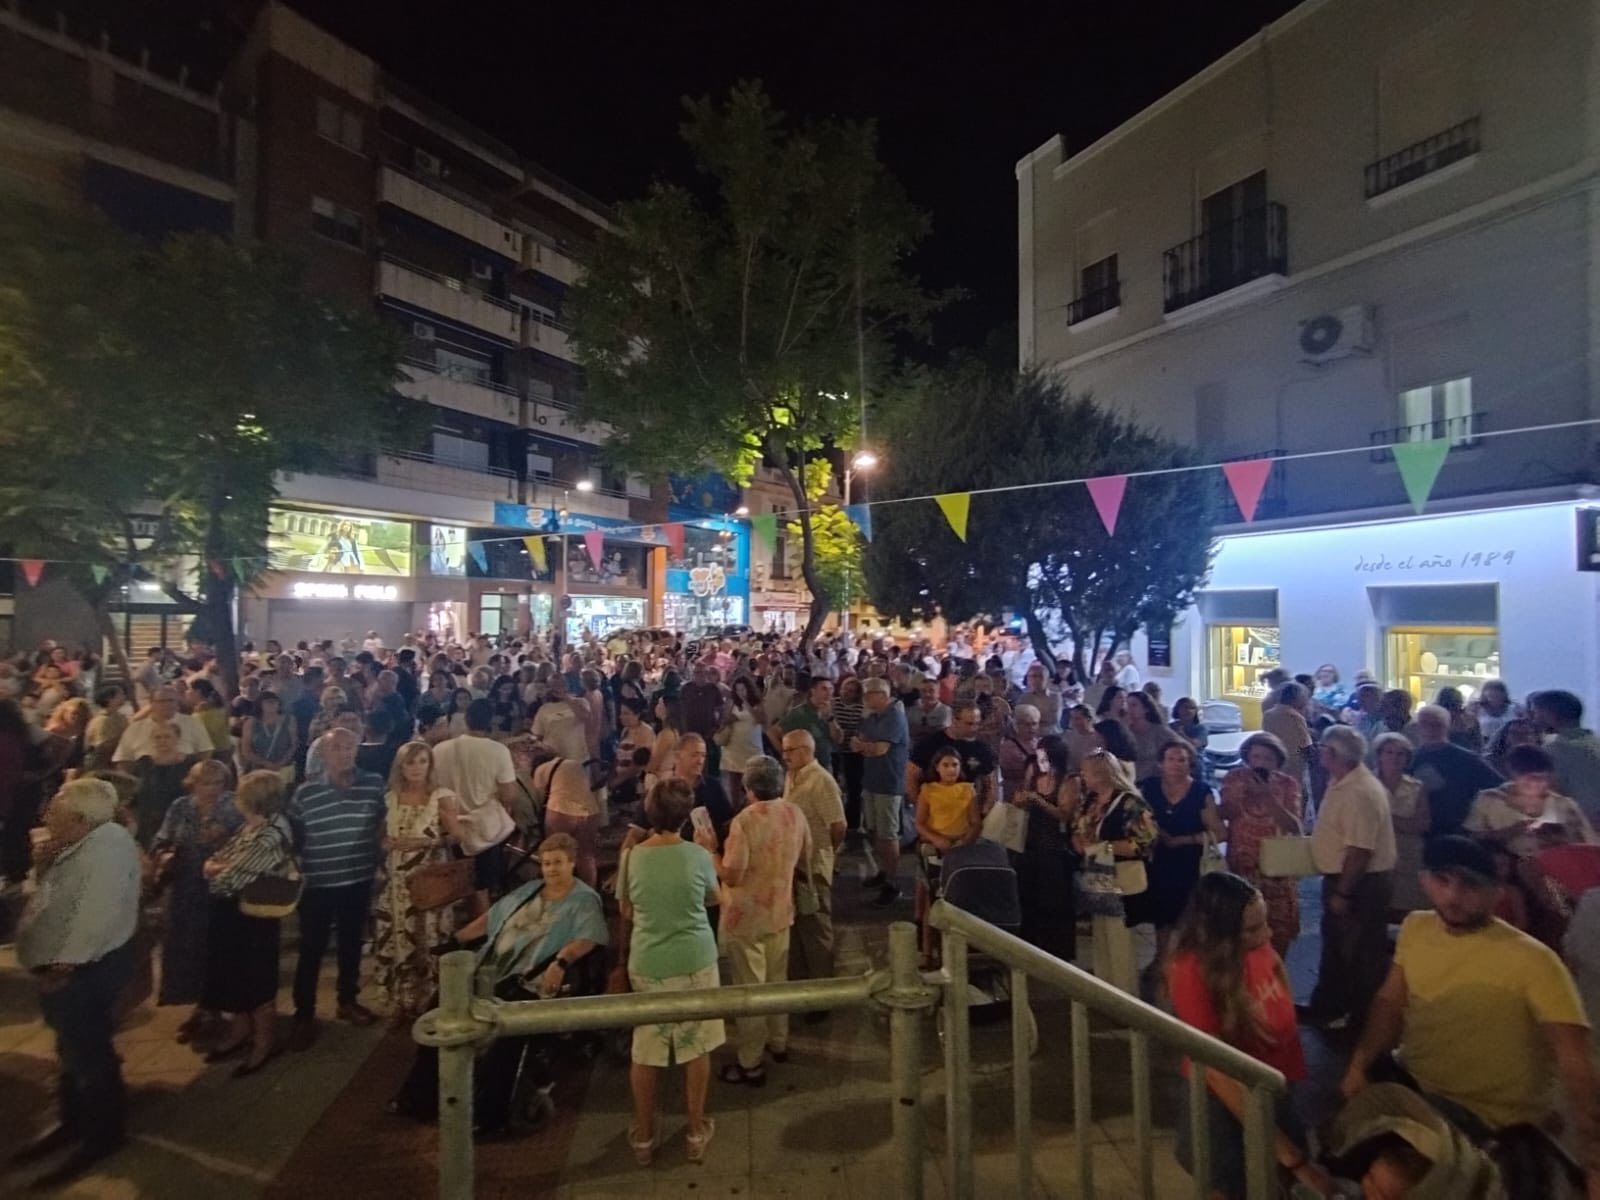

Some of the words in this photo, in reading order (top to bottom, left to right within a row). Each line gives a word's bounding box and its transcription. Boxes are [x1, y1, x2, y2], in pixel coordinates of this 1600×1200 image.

[1354, 553, 1392, 572] desde
[1398, 554, 1414, 570] el
[1419, 554, 1453, 569] año
[1460, 549, 1516, 569] 1989
